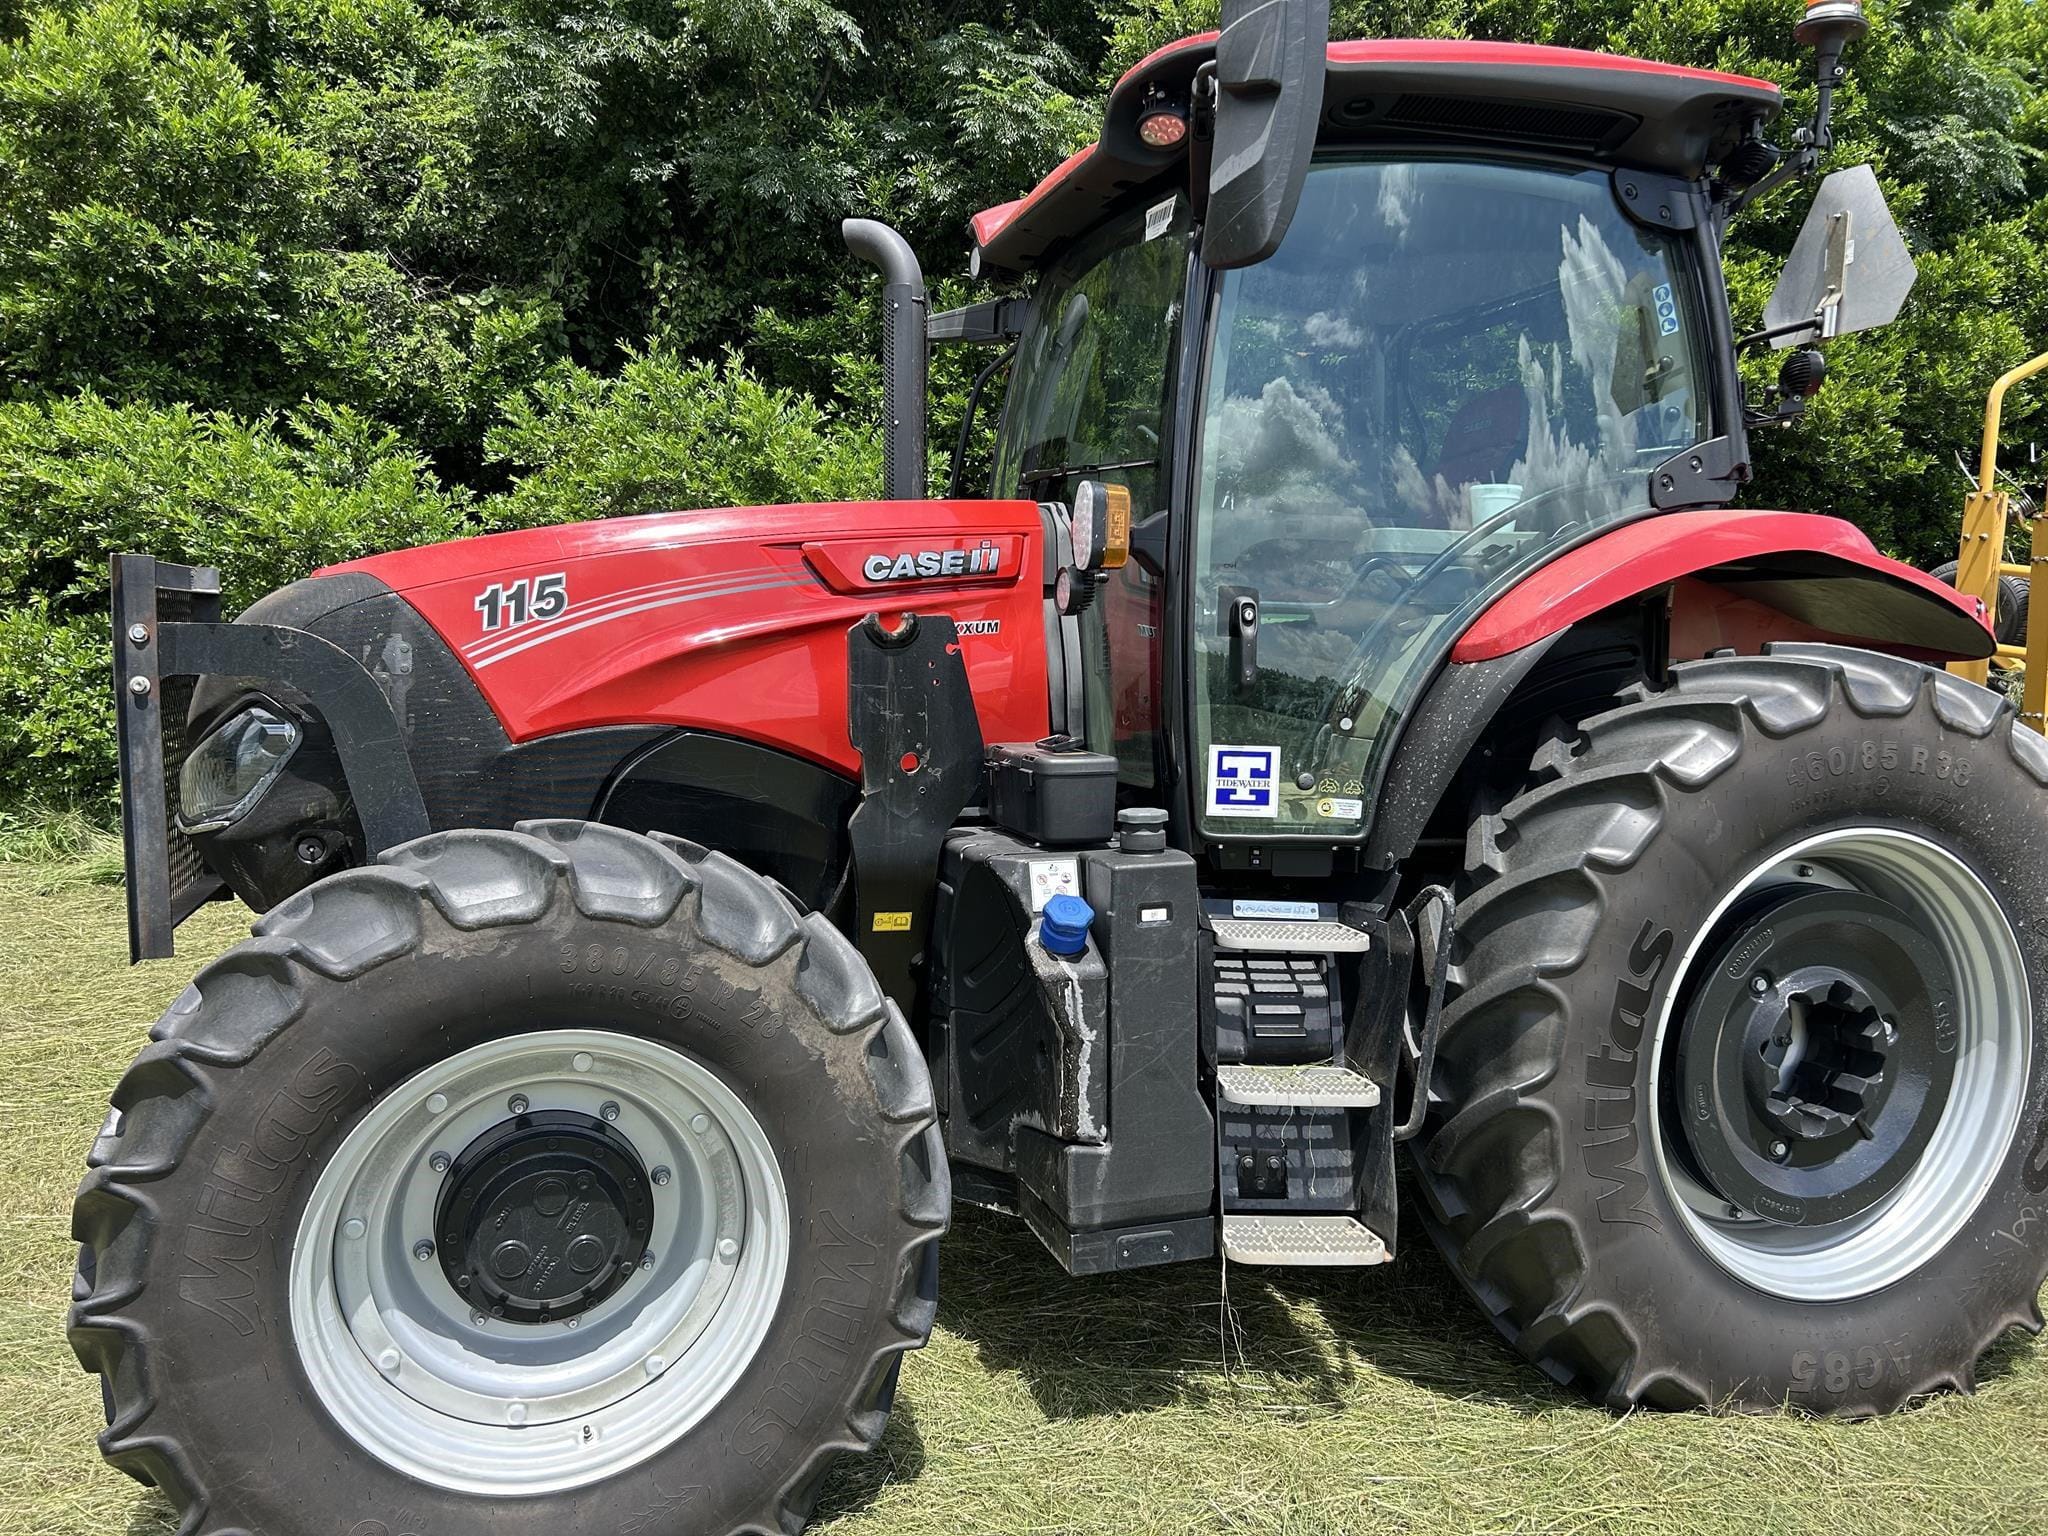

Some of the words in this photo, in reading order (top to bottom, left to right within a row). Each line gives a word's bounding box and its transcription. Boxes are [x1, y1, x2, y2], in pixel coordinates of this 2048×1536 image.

[474, 572, 568, 632] 115
[863, 550, 965, 581] CASE
[1215, 779, 1271, 789] TIDEWATER
[1908, 744, 1930, 776] R
[1934, 750, 1974, 788] 38
[559, 943, 704, 993] 380/85
[740, 1000, 784, 1039] 28
[1581, 917, 1675, 1235] Mitas
[178, 1046, 361, 1337] Mitas
[730, 1208, 880, 1470] Mitas
